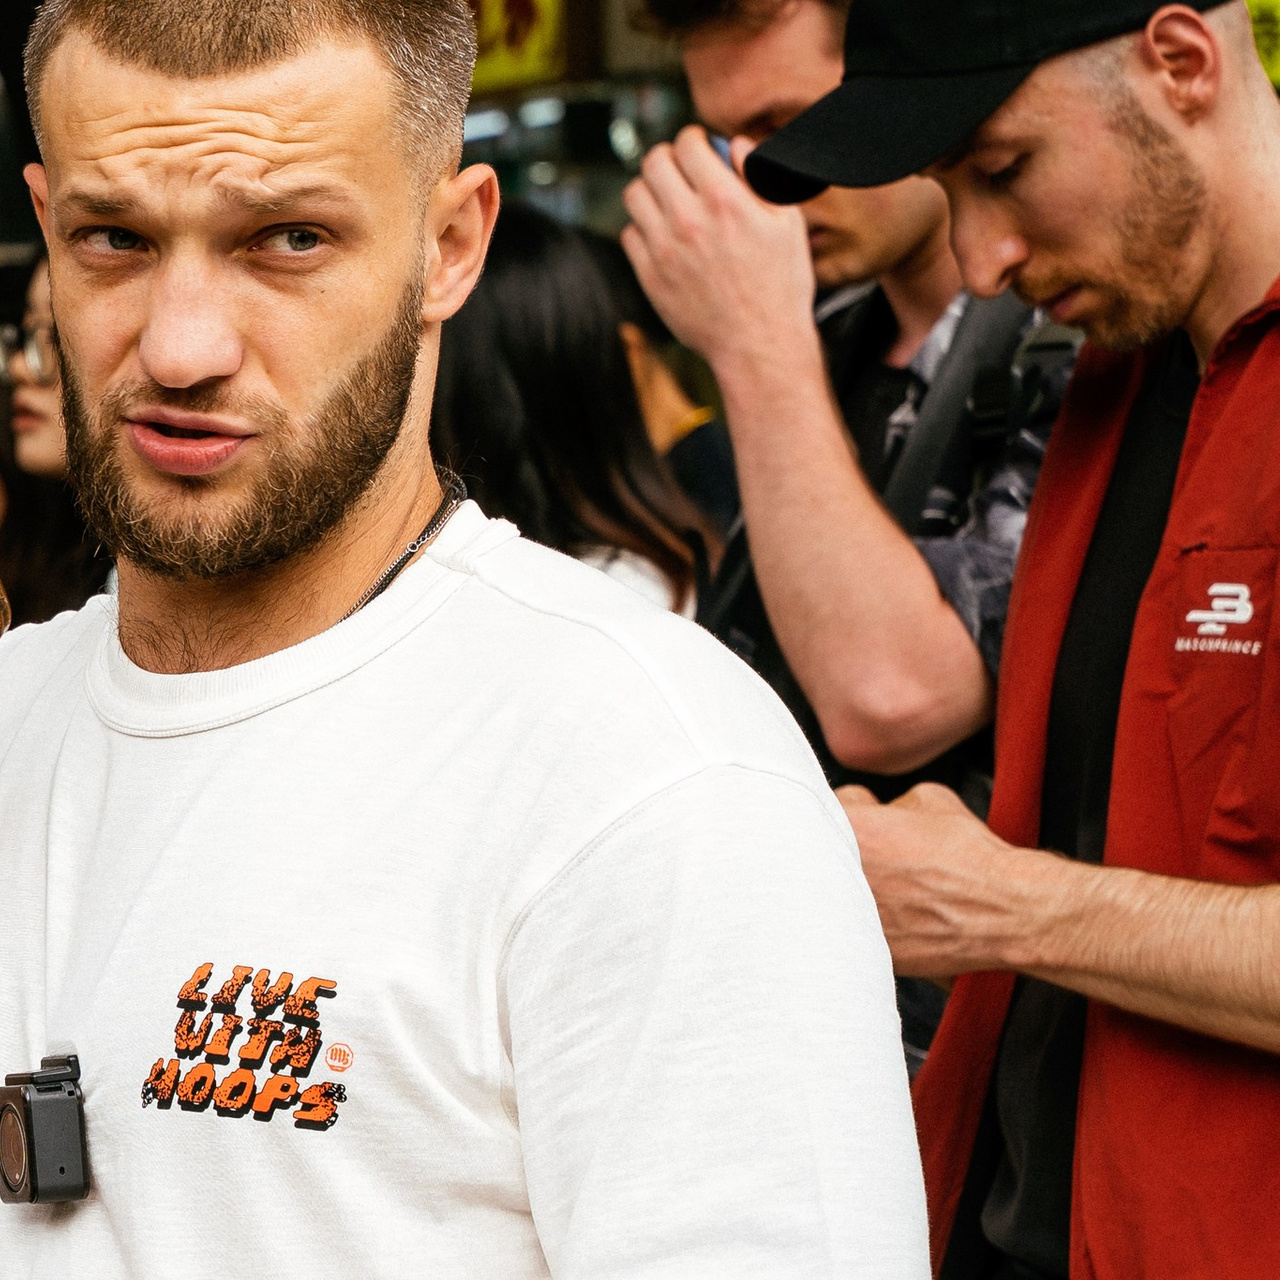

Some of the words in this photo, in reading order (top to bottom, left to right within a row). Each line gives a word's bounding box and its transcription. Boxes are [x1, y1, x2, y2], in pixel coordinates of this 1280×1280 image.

[176, 962, 338, 1029] LIVE
[174, 1009, 323, 1078] WITH
[141, 1057, 348, 1131] HOOPS
